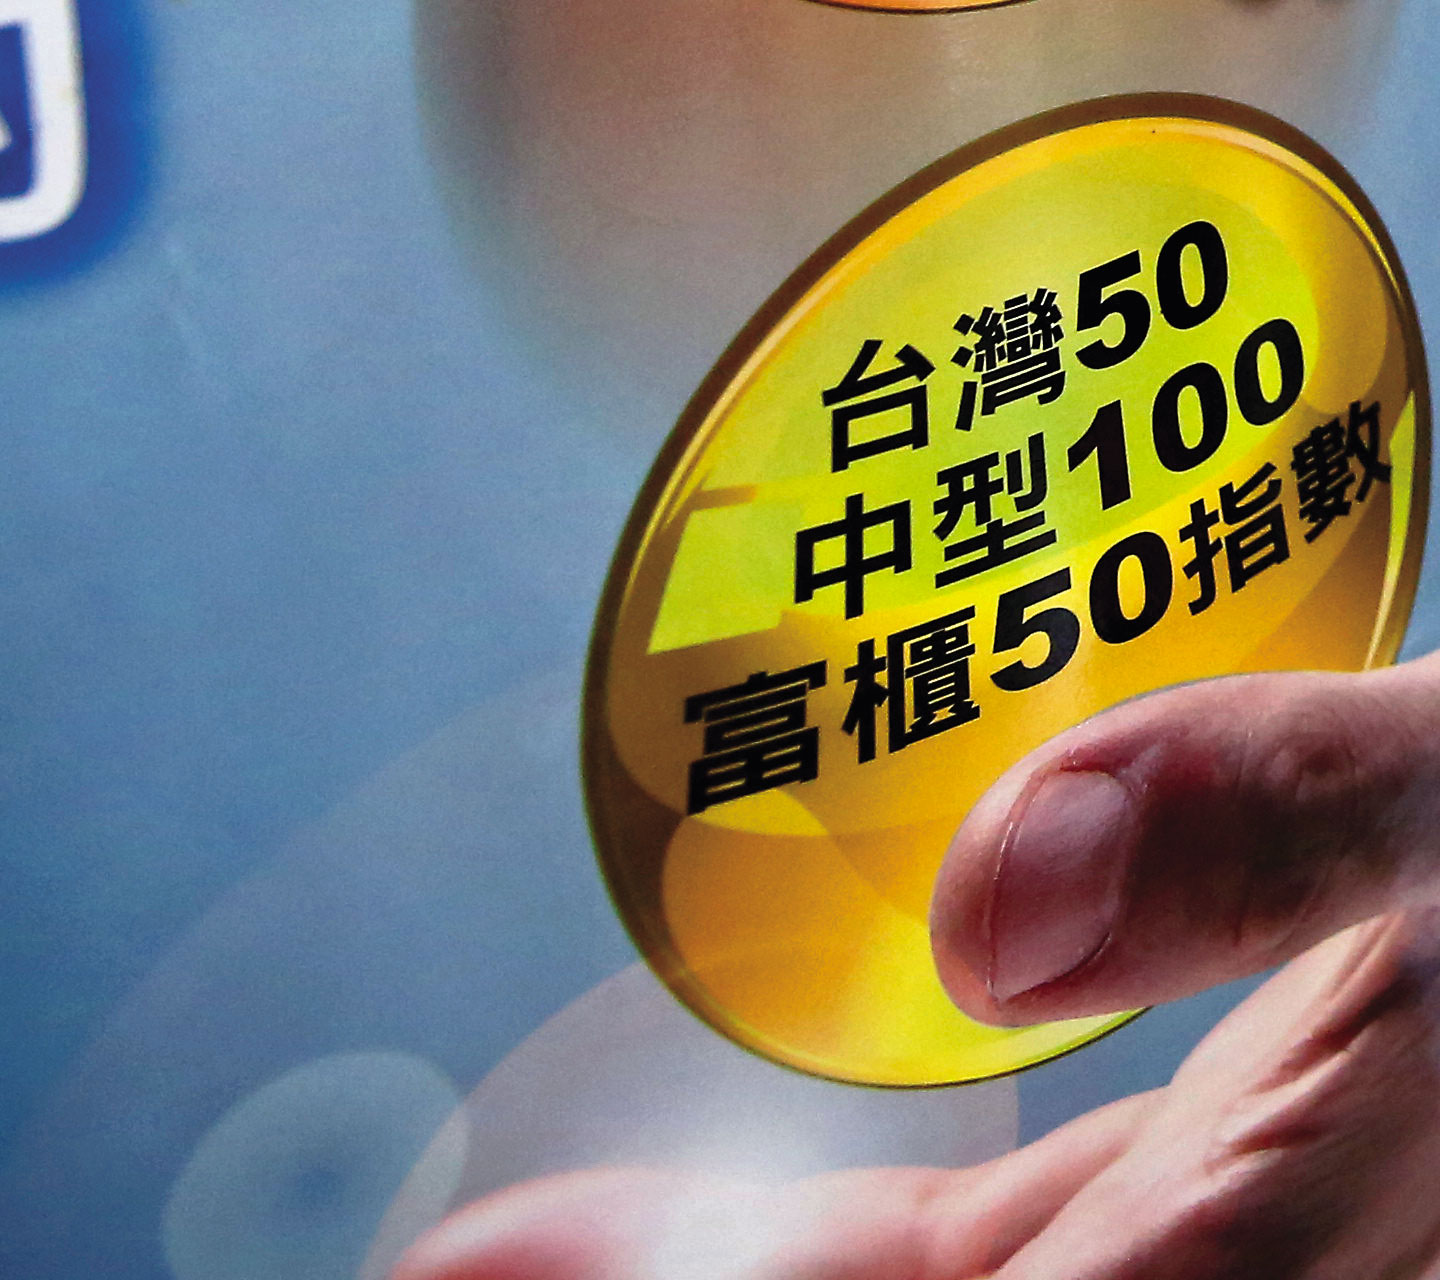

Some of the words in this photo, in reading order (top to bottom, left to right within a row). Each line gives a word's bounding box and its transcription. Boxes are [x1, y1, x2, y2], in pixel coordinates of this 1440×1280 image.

[792, 316, 1308, 623] 中型100
[821, 219, 1230, 476] 台灣50
[680, 400, 1398, 817] 富櫃50指數
